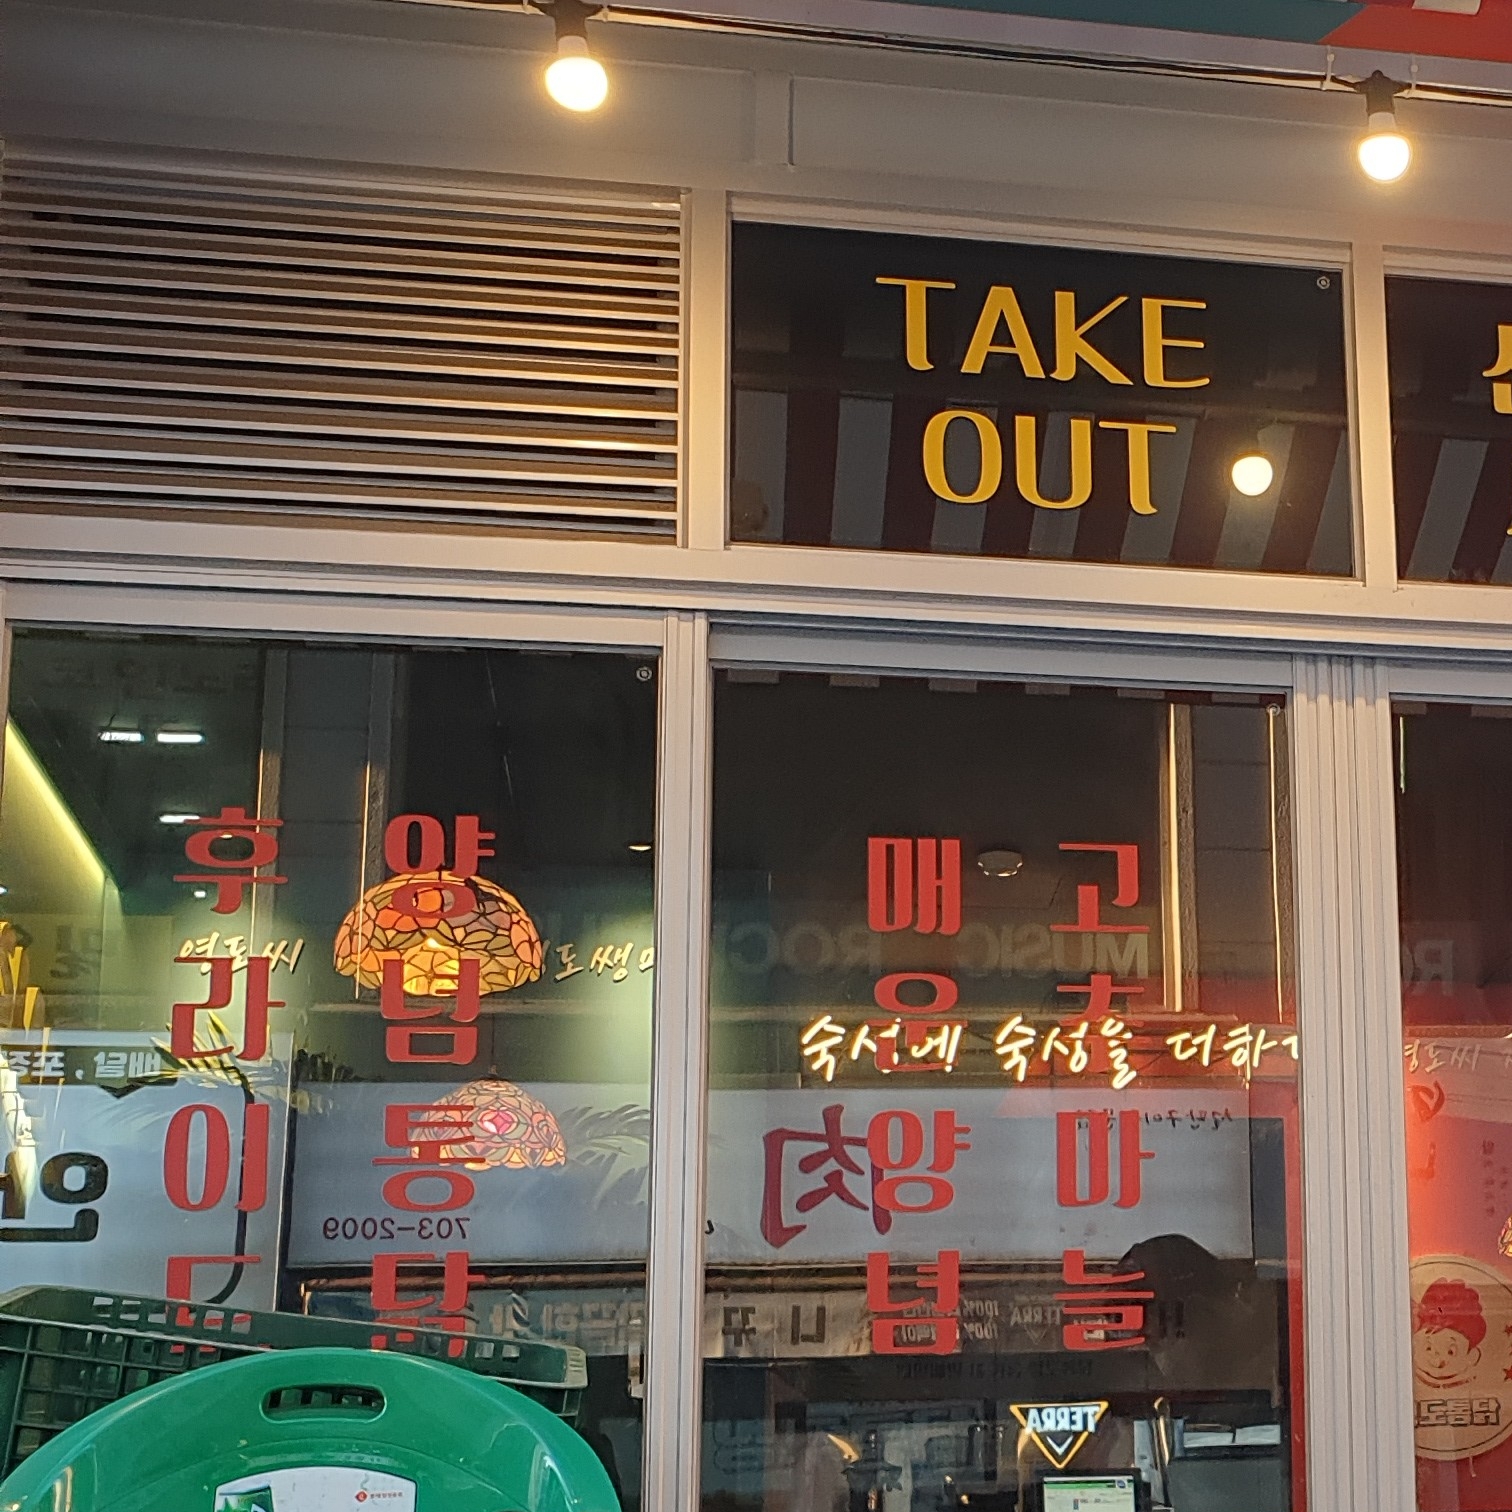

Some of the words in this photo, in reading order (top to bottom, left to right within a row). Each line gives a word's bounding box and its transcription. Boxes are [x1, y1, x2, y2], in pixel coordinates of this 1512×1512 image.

[876, 277, 1210, 388] TAKE
[923, 410, 1177, 515] OUT
[1414, 1396, 1502, 1428] 도통닭
